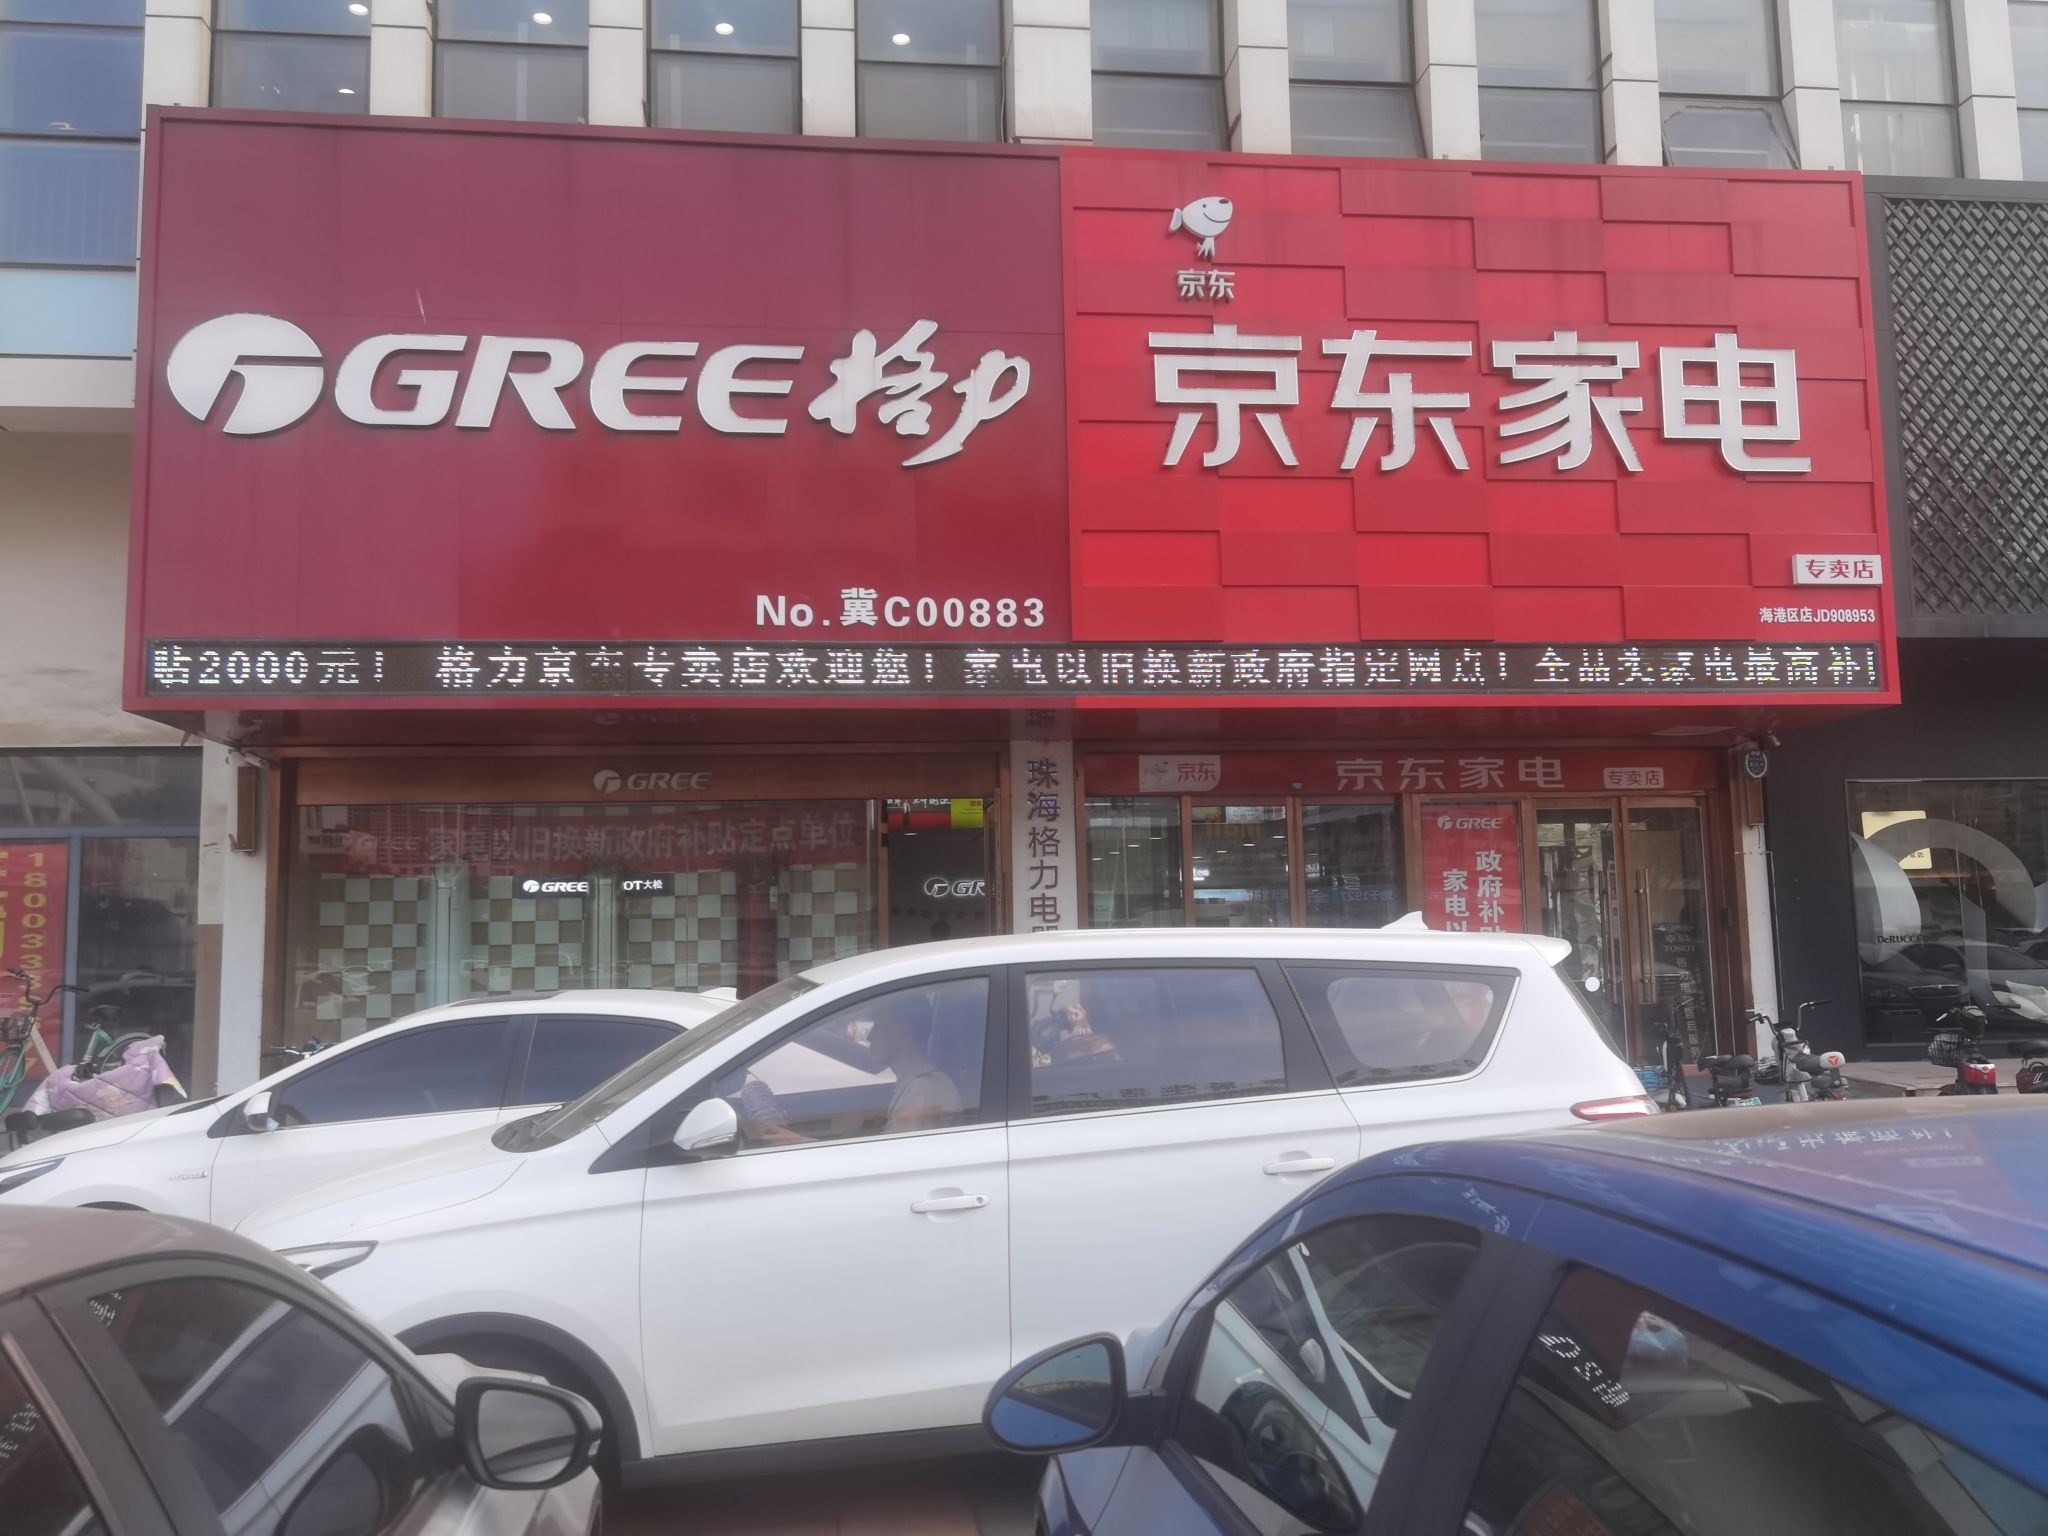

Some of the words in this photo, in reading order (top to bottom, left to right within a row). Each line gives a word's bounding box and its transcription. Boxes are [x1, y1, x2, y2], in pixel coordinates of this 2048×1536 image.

[1177, 269, 1235, 300] 京东
[334, 333, 805, 434] GREE
[807, 318, 1032, 468] 格力
[1148, 324, 1812, 473] 京东家电
[1805, 559, 1874, 579] 专卖店
[626, 771, 711, 791] GREE
[1176, 762, 1217, 782] 京东
[1335, 757, 1566, 791] 京东家电
[1607, 769, 1661, 788] 专卖店
[1456, 817, 1505, 830] GREE
[541, 881, 589, 893] GREE
